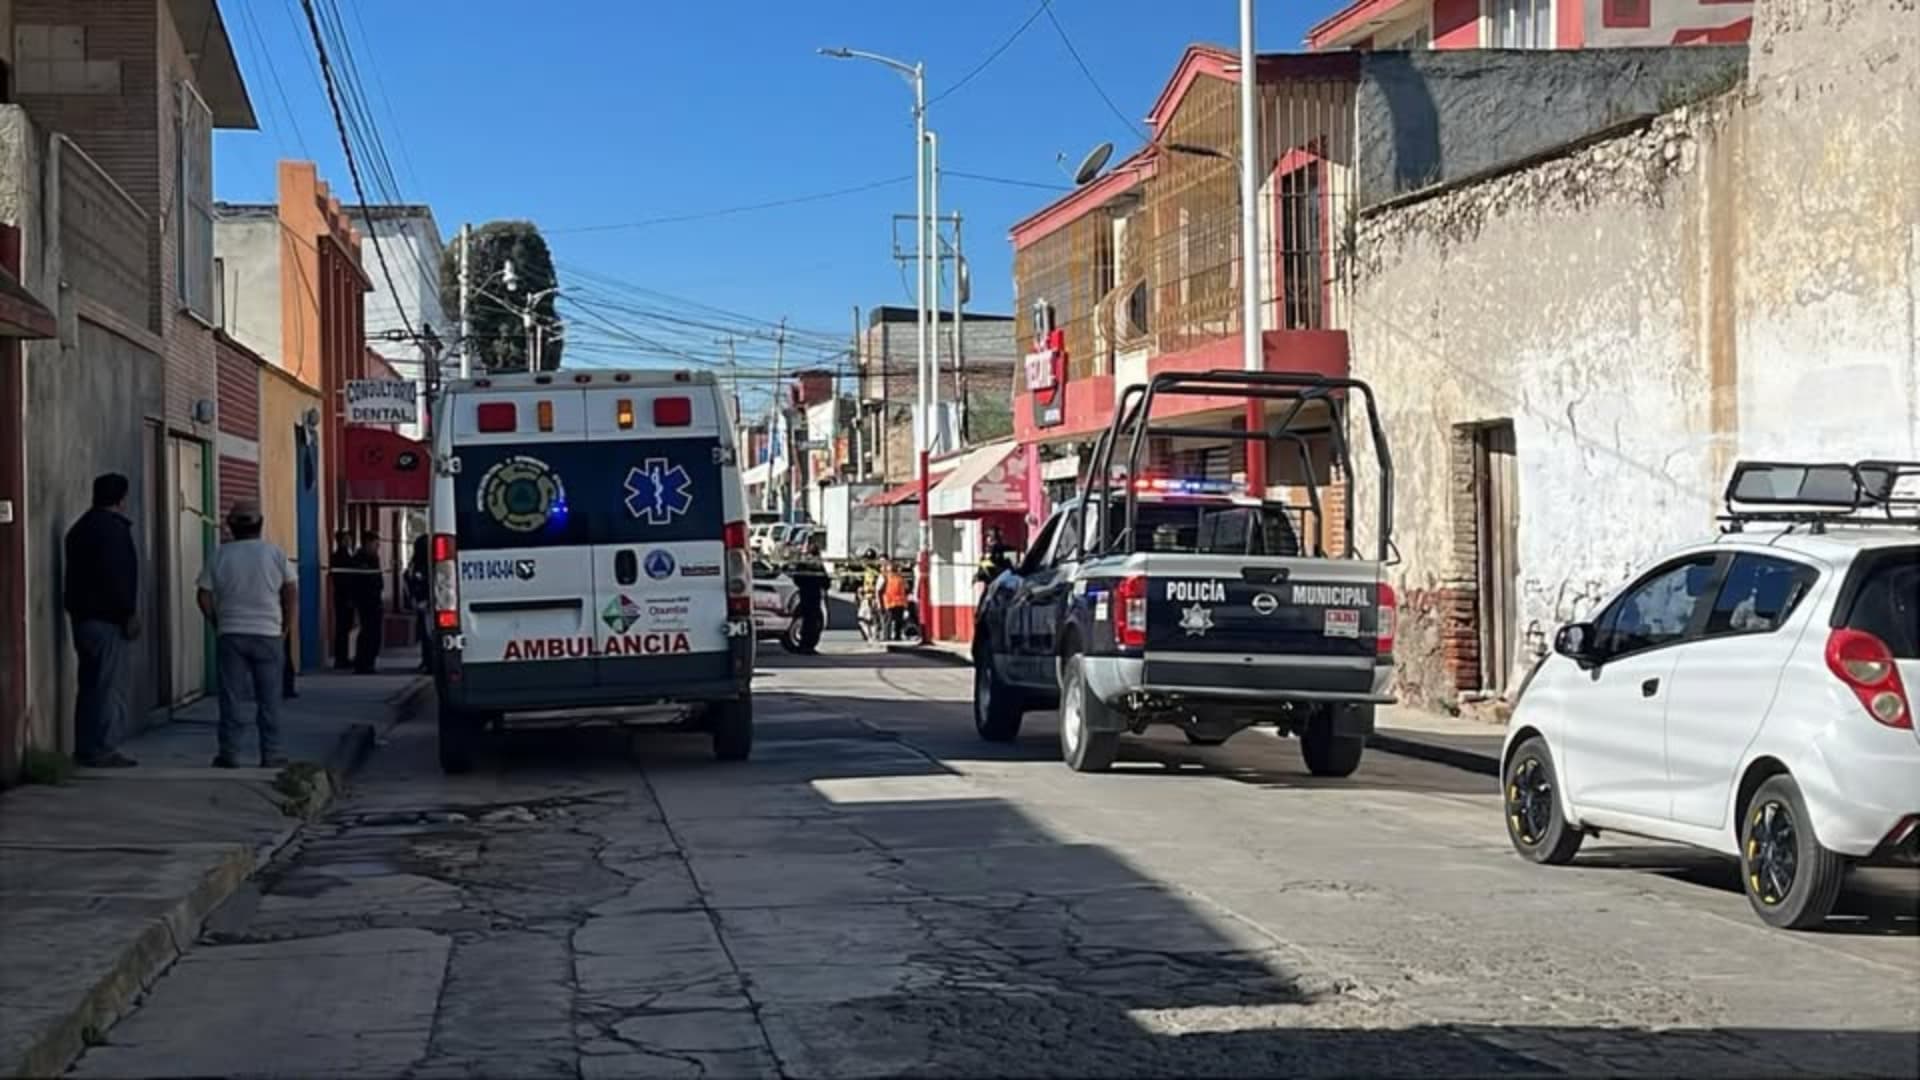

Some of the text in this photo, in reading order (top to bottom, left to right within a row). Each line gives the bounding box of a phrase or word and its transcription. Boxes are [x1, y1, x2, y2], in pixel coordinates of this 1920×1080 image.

[347, 381, 416, 404] CONSULTORIO
[353, 407, 410, 421] DENTAL
[1166, 578, 1226, 602] POLICÍA
[1293, 585, 1371, 607] MUNICIPAL
[504, 633, 690, 660] AMBULANCIA
